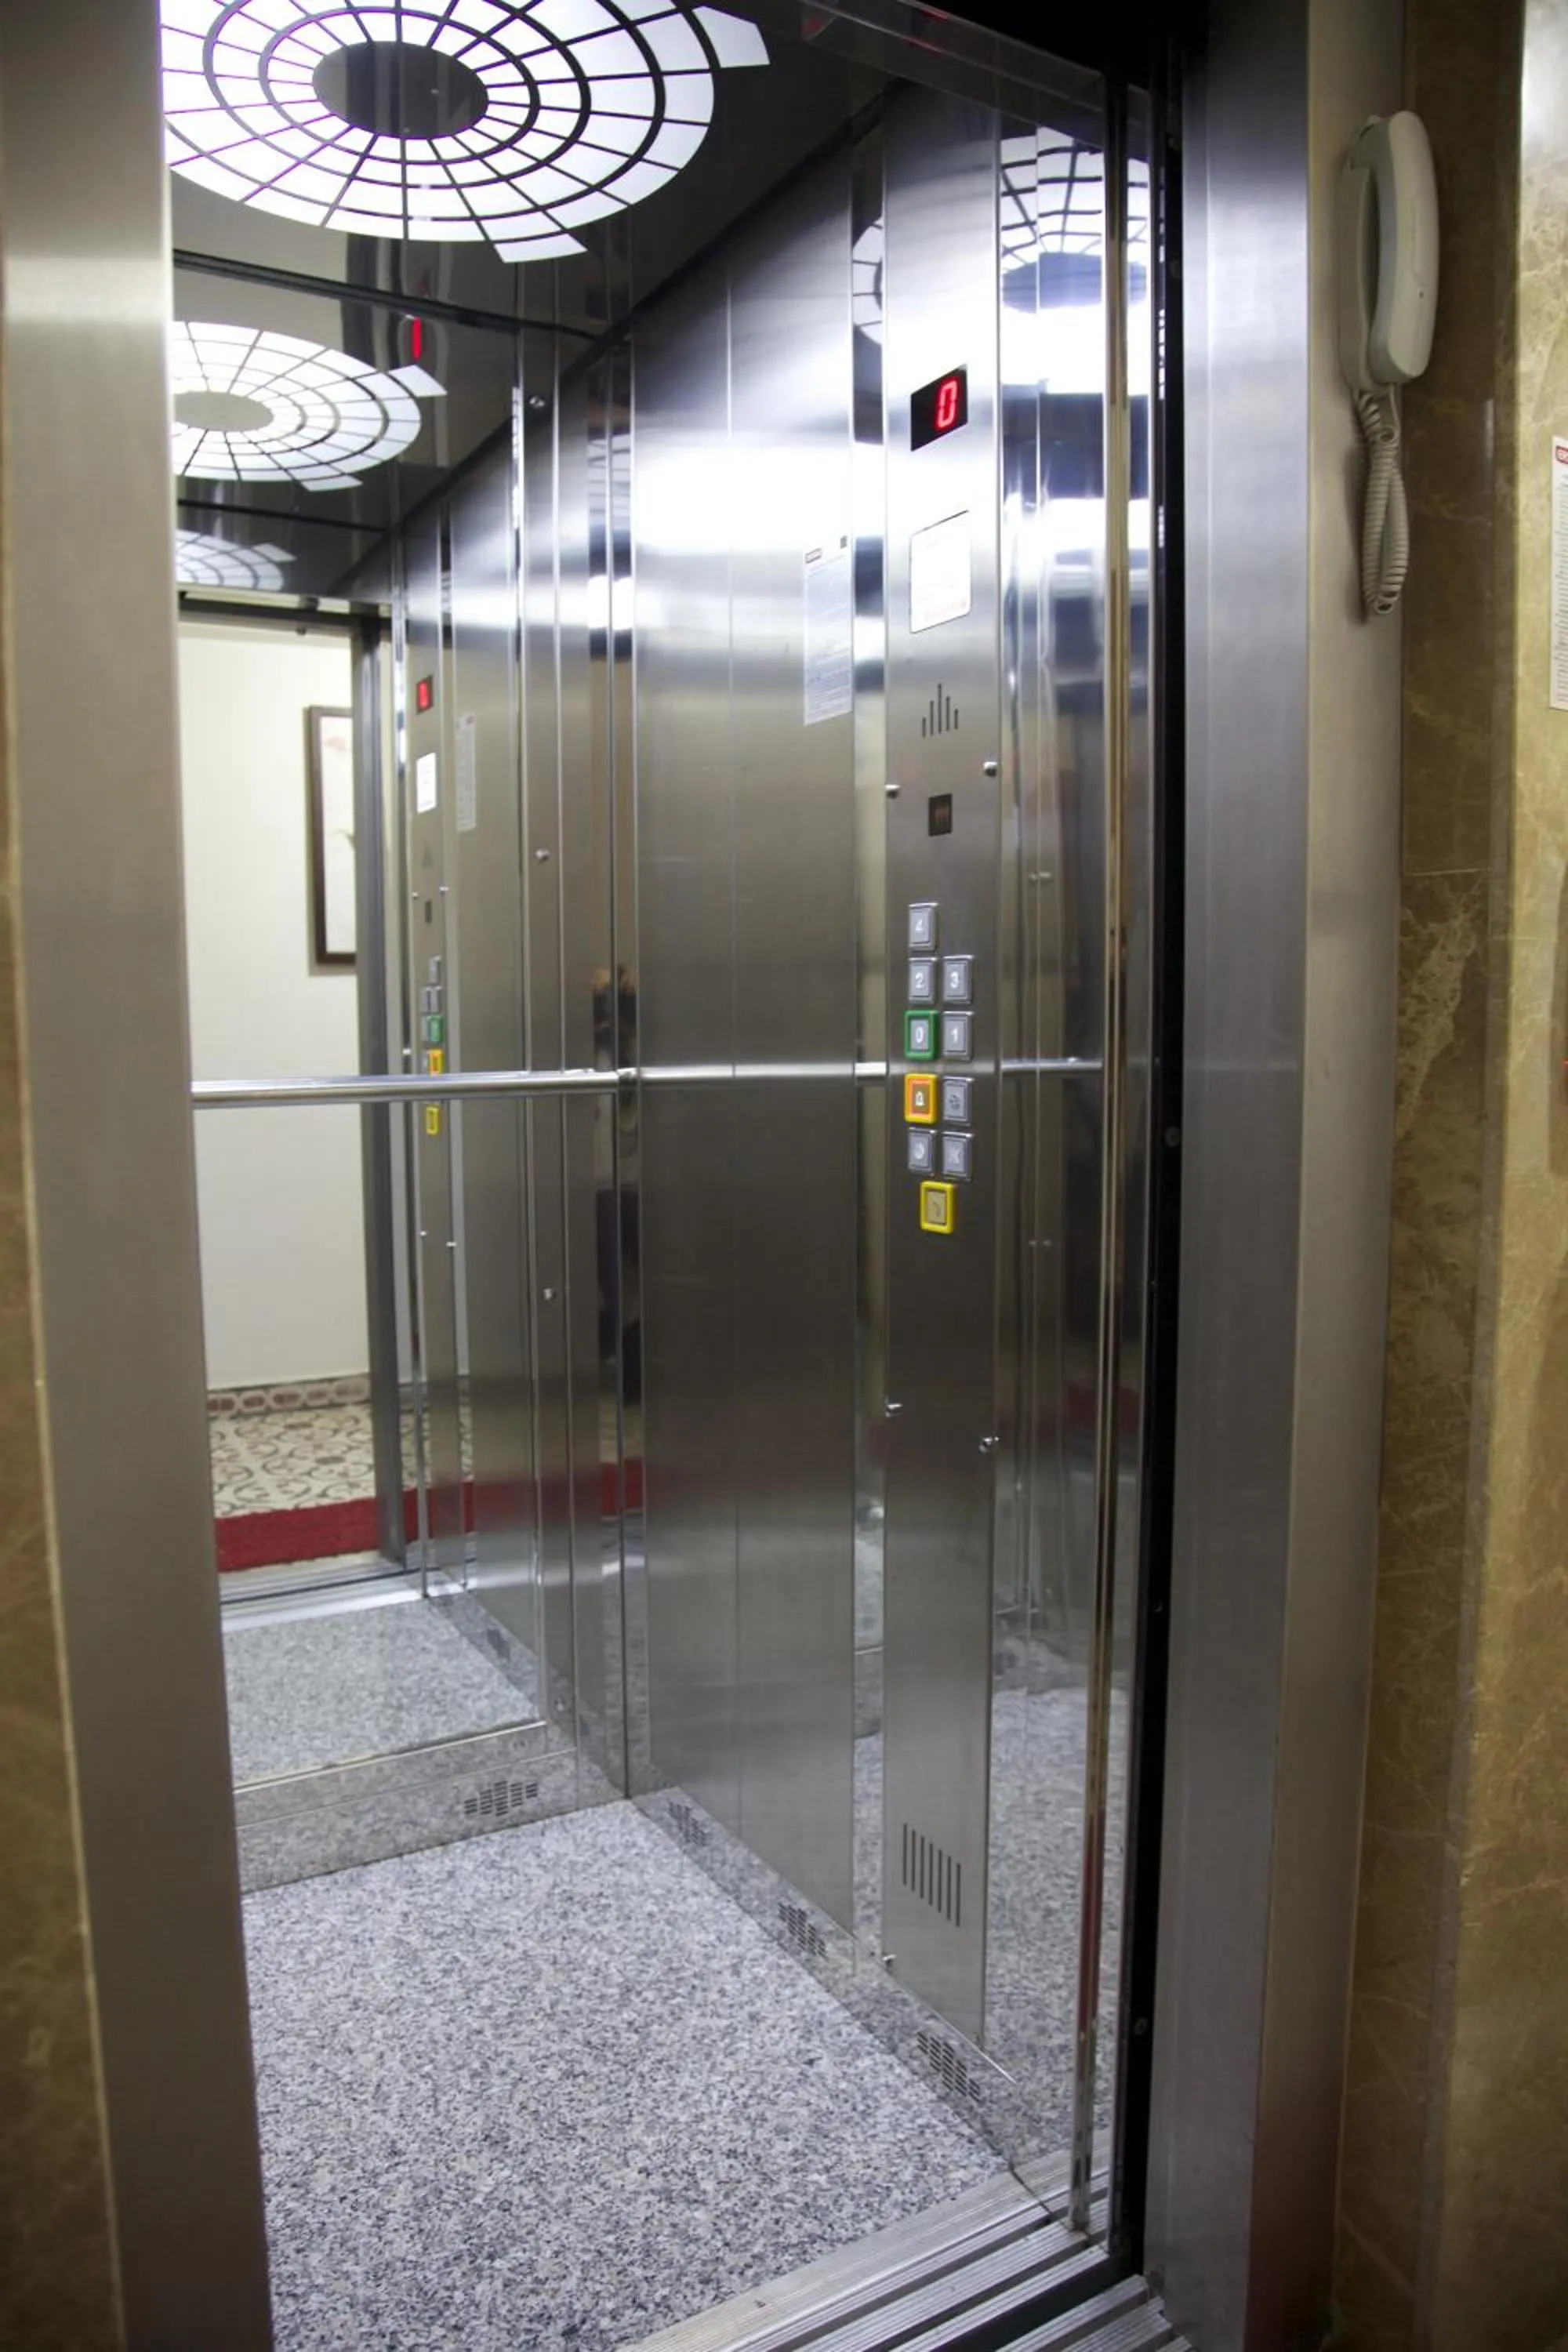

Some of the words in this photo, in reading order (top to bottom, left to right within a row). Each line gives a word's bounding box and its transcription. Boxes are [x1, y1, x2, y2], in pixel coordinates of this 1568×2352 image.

[938, 379, 957, 428] 0
[915, 918, 924, 932] 4
[915, 972, 924, 989] 2
[950, 971, 959, 989] 3
[916, 1026, 924, 1044] 0
[951, 1027, 958, 1044] 1
